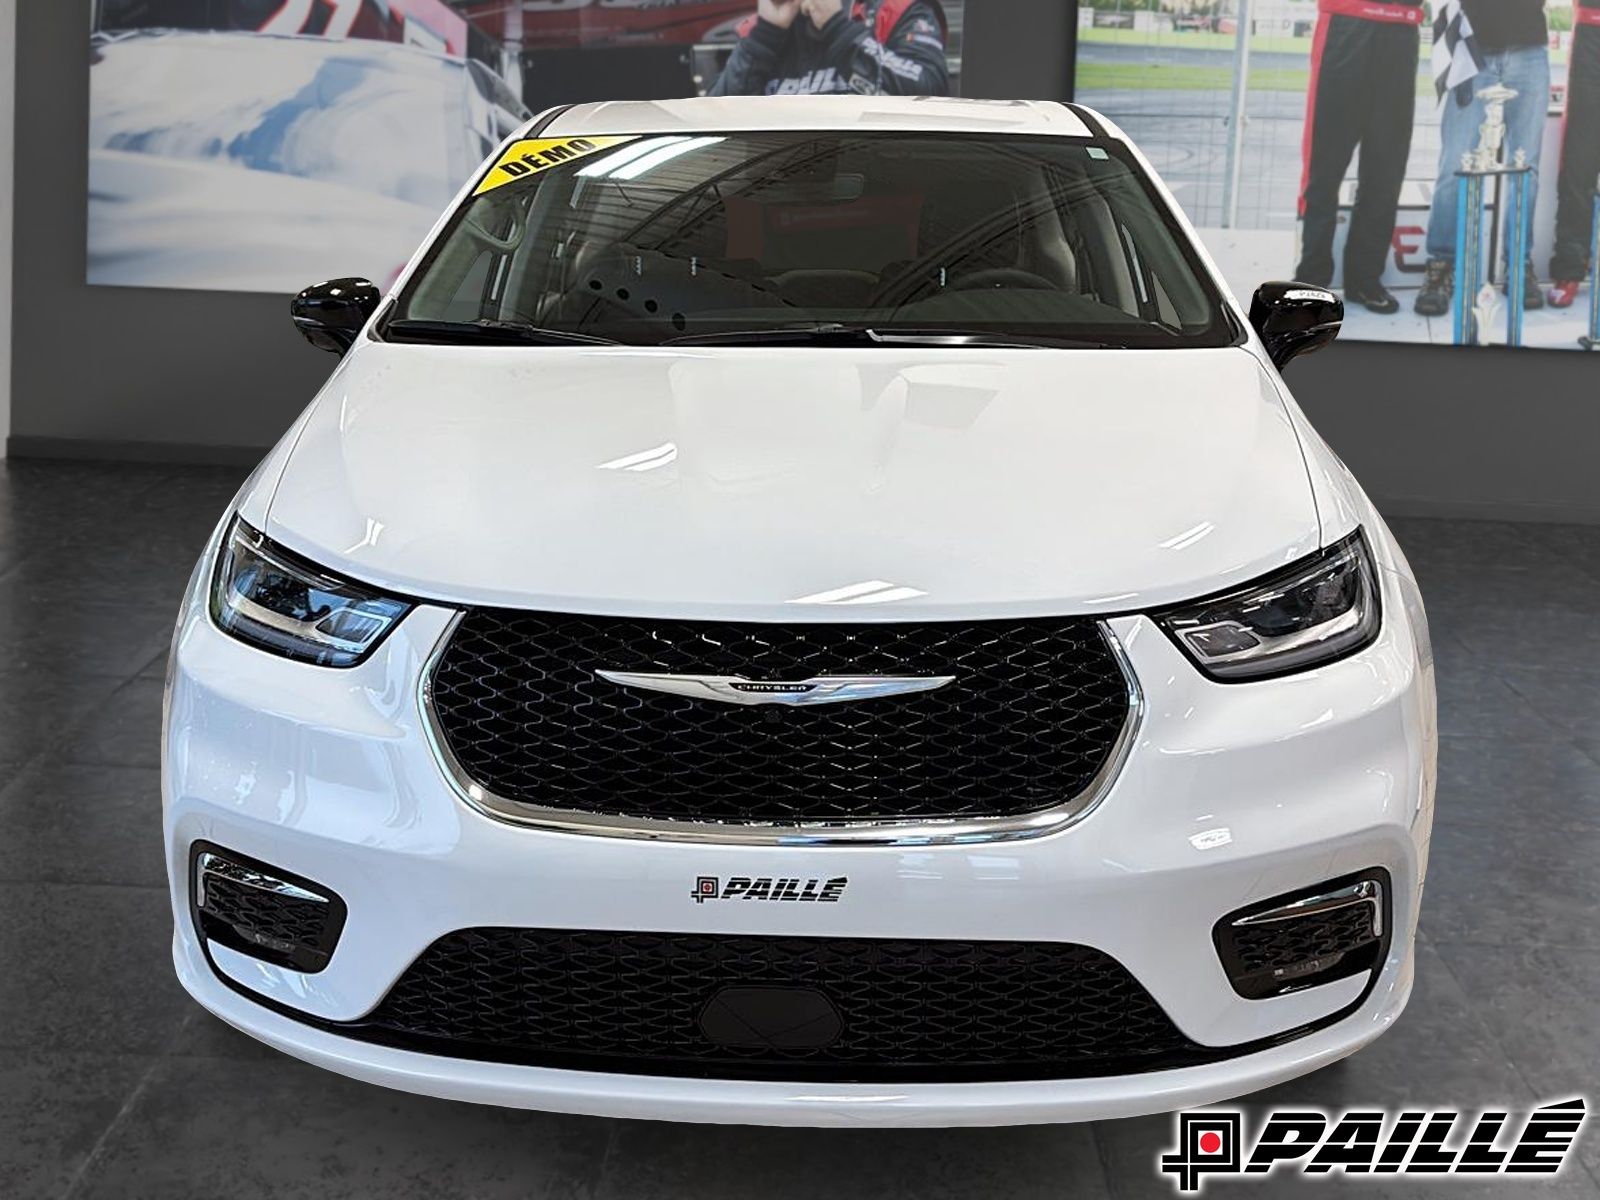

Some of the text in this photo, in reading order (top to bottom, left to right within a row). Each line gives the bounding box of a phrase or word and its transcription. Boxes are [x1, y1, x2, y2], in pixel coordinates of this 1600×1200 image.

[499, 139, 596, 177] DÉMO
[737, 684, 807, 692] CHRYSLER
[720, 877, 848, 902] PAILLÉ
